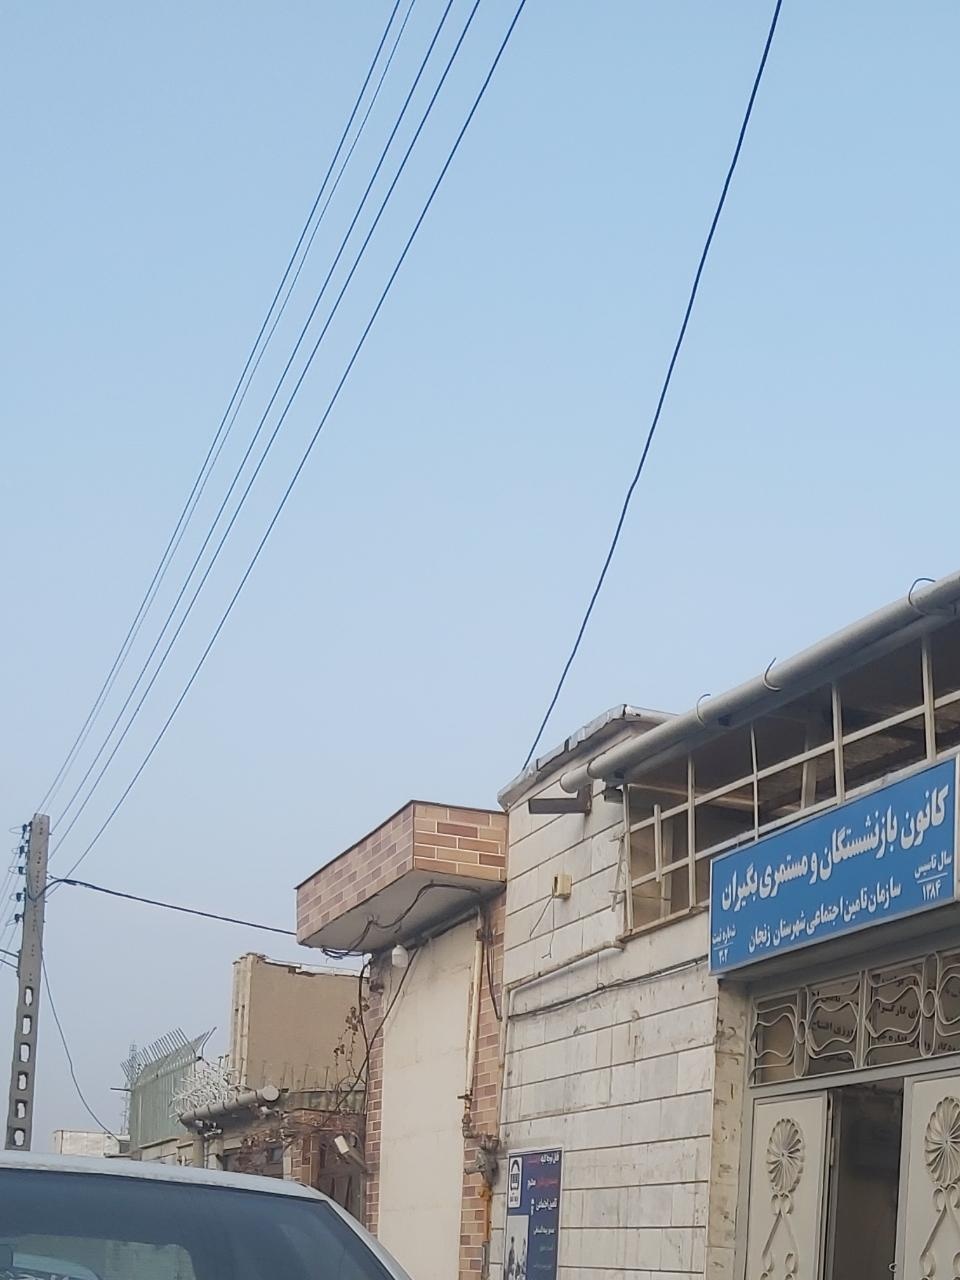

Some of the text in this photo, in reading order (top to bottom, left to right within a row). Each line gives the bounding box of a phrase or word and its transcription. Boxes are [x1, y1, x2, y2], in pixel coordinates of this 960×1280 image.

[722, 784, 949, 912] کانون بازنشستگان و مستمری بگیران
[914, 850, 952, 879] سال تاسیس
[748, 876, 902, 953] سازمان تامین اجتماعی شهرستان زنجان
